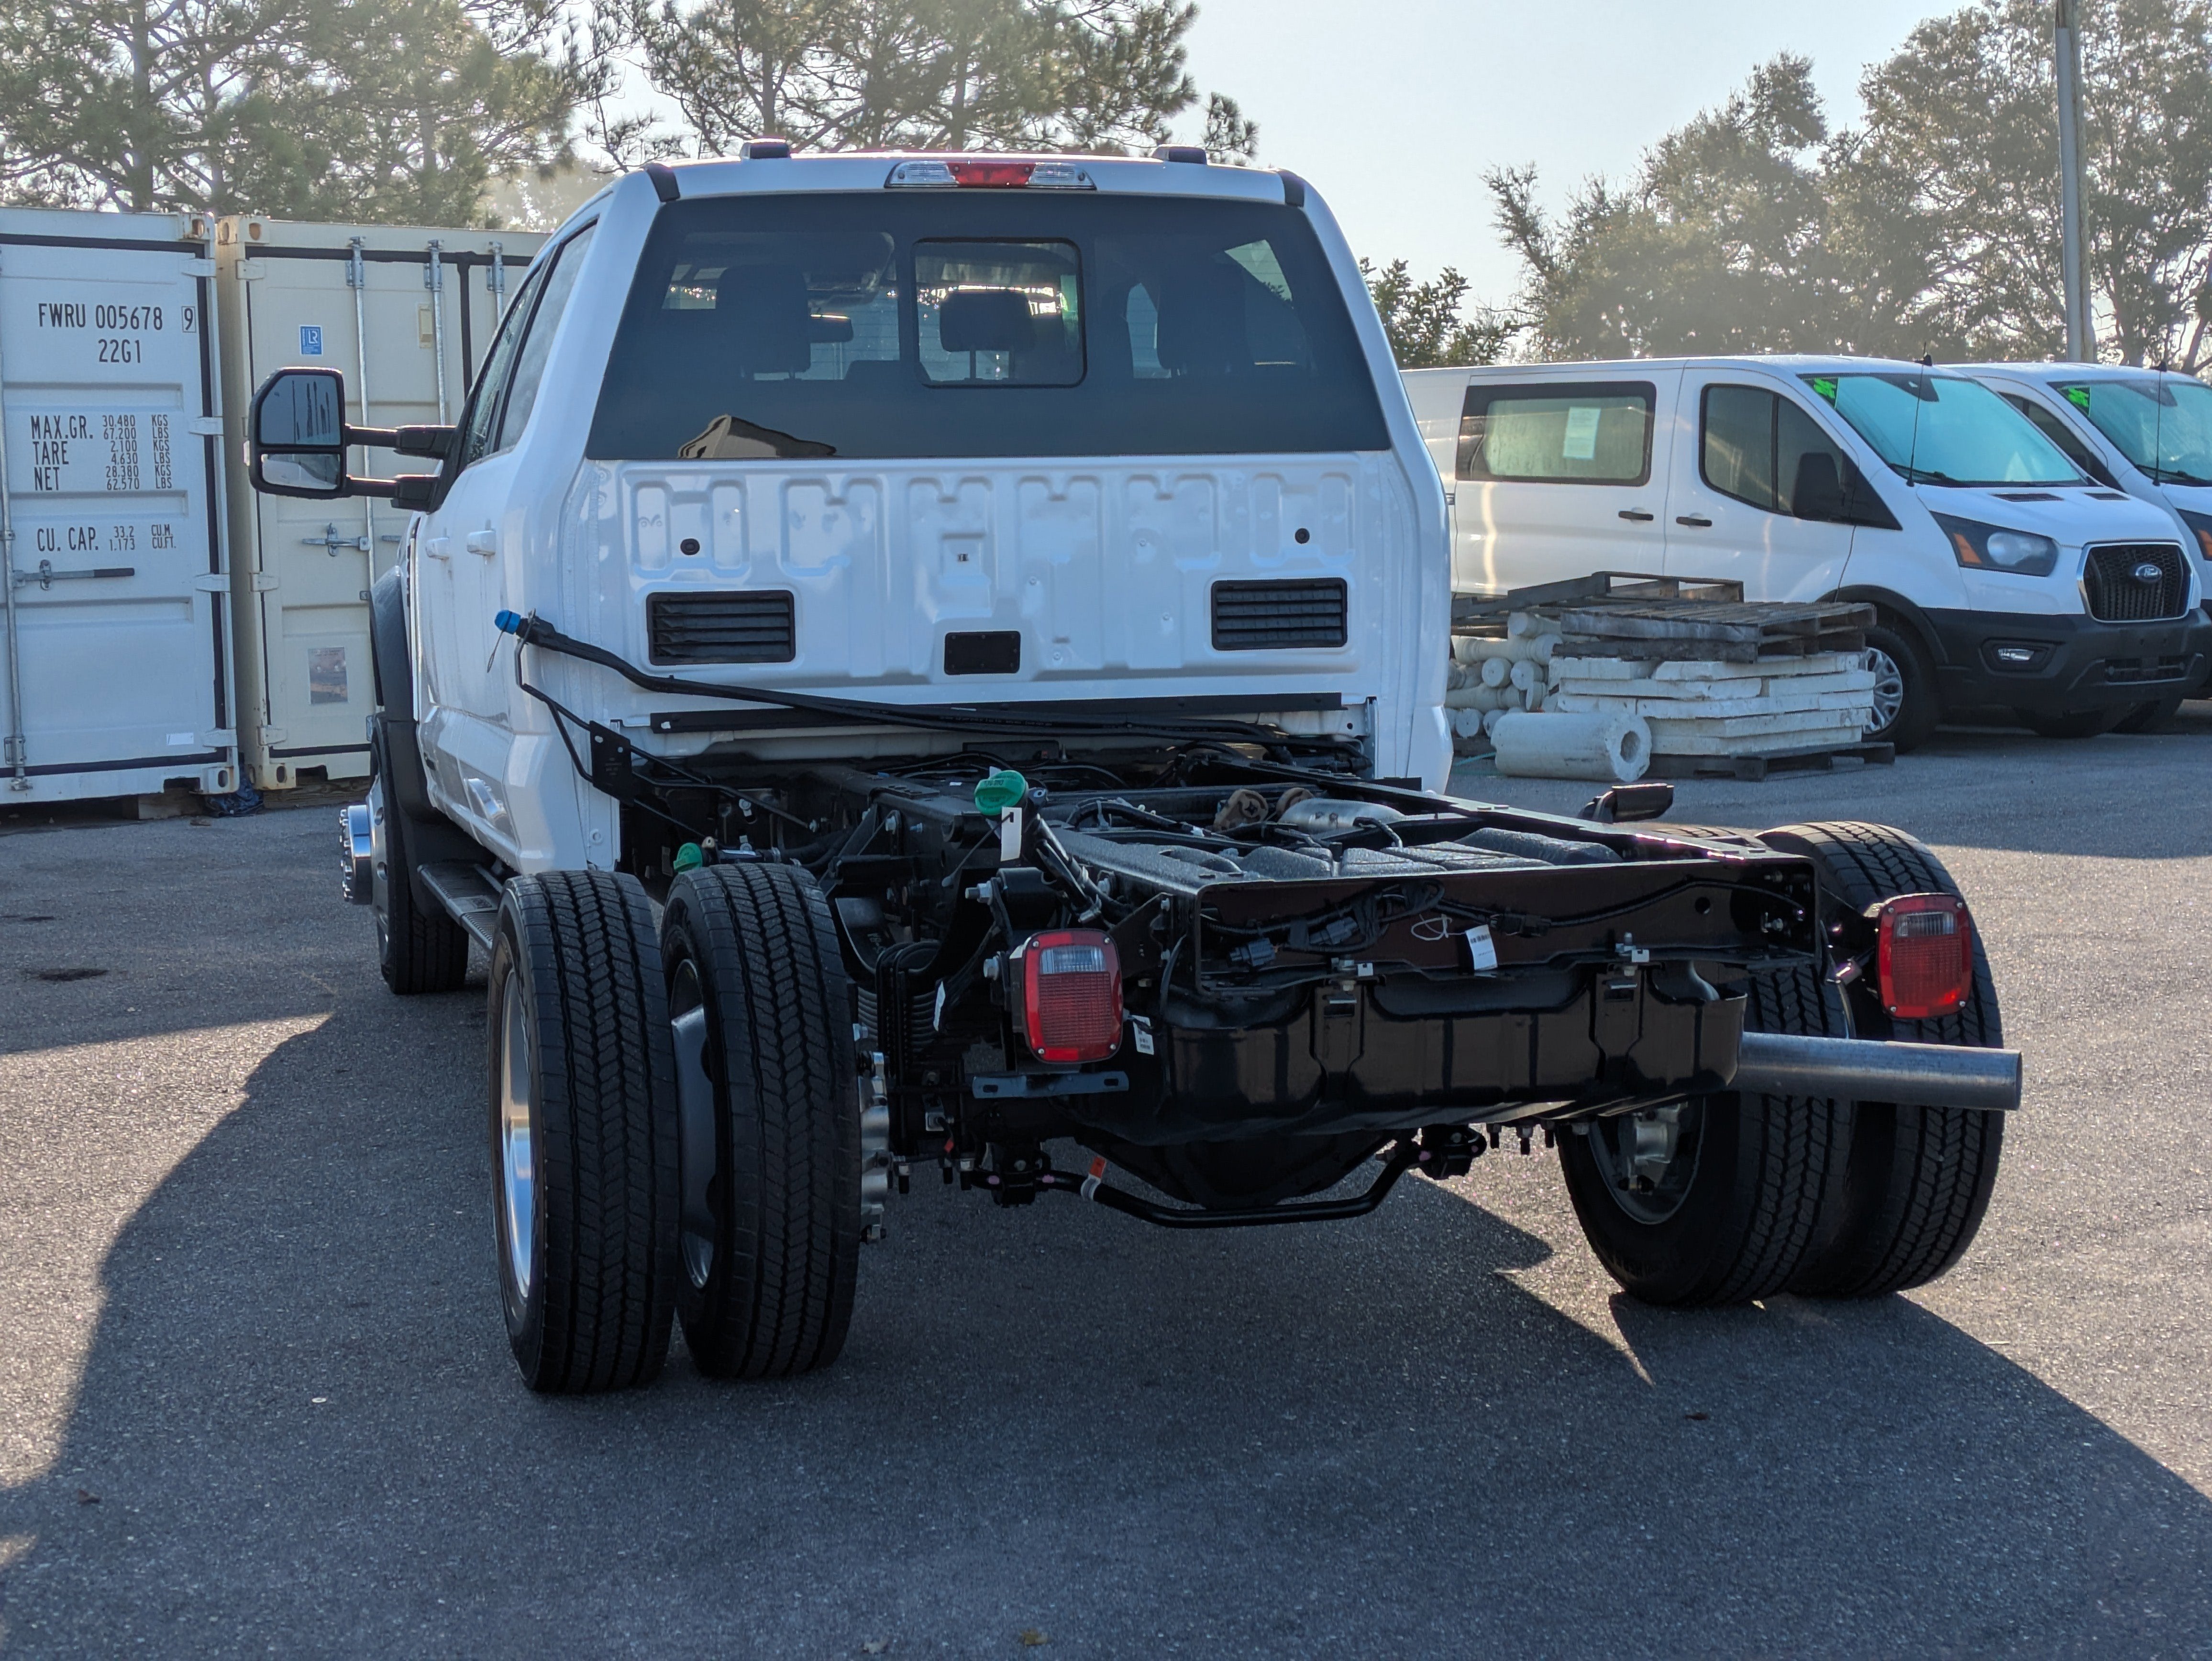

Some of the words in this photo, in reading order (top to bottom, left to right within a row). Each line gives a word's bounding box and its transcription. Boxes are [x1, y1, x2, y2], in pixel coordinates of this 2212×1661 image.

[38, 303, 86, 328] FWRU
[95, 304, 163, 330] 005678
[184, 308, 194, 331] 9
[98, 339, 141, 363] 22G1
[31, 415, 93, 439] MAX.GR.
[102, 414, 136, 427] 30.480
[151, 414, 169, 427] KGS
[103, 427, 137, 440] 67.200
[152, 427, 169, 440] LBS
[32, 441, 69, 465] TARE
[153, 439, 170, 452] KGS
[111, 452, 138, 465] 4.630
[154, 452, 171, 465] LBS
[34, 466, 60, 491] NET
[105, 465, 139, 478] 28.380
[155, 464, 171, 477] KGS
[155, 476, 172, 489] LBS
[37, 528, 61, 552] CU.
[68, 527, 99, 551] CAP.
[114, 526, 134, 538] 33.2
